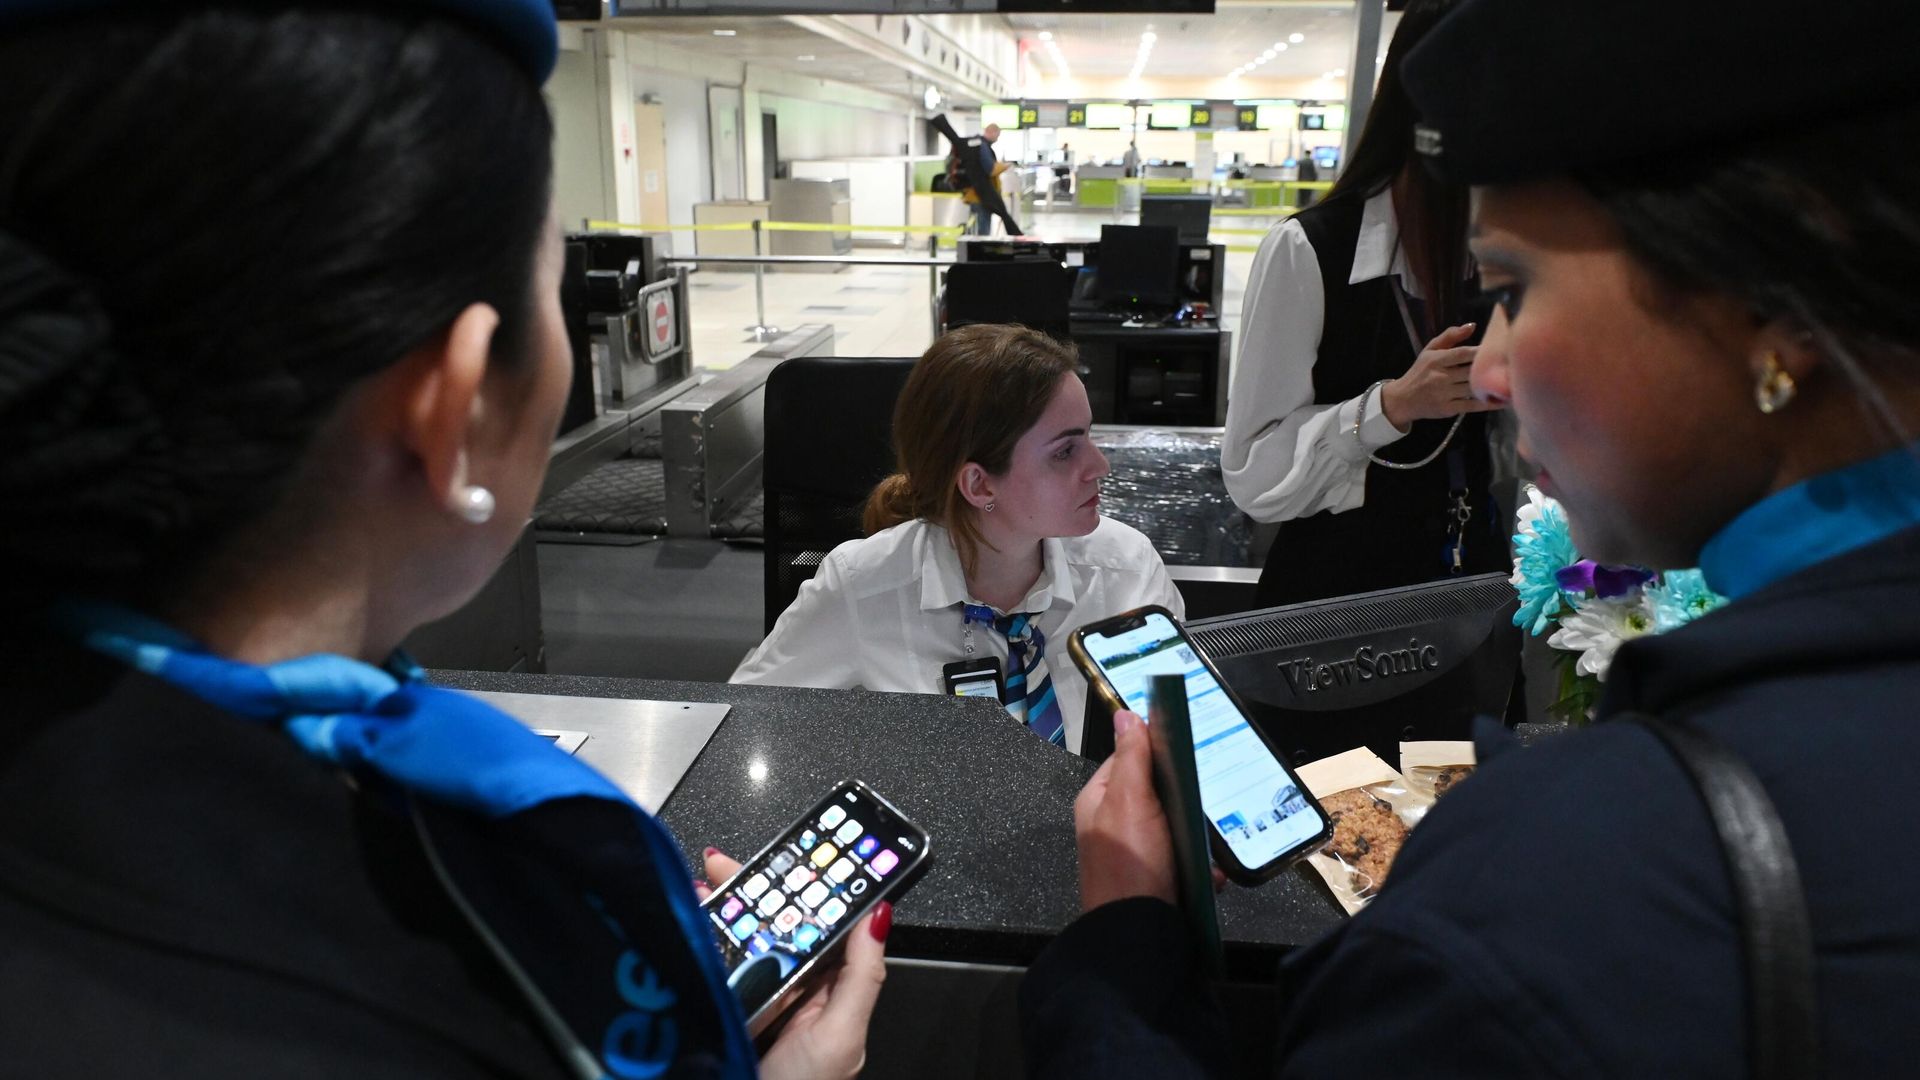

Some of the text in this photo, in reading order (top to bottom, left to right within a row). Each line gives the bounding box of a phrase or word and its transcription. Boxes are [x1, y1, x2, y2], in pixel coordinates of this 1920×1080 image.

[1021, 110, 1037, 123] 22
[1069, 110, 1084, 123] 21
[1277, 637, 1439, 696] ViewSonic
